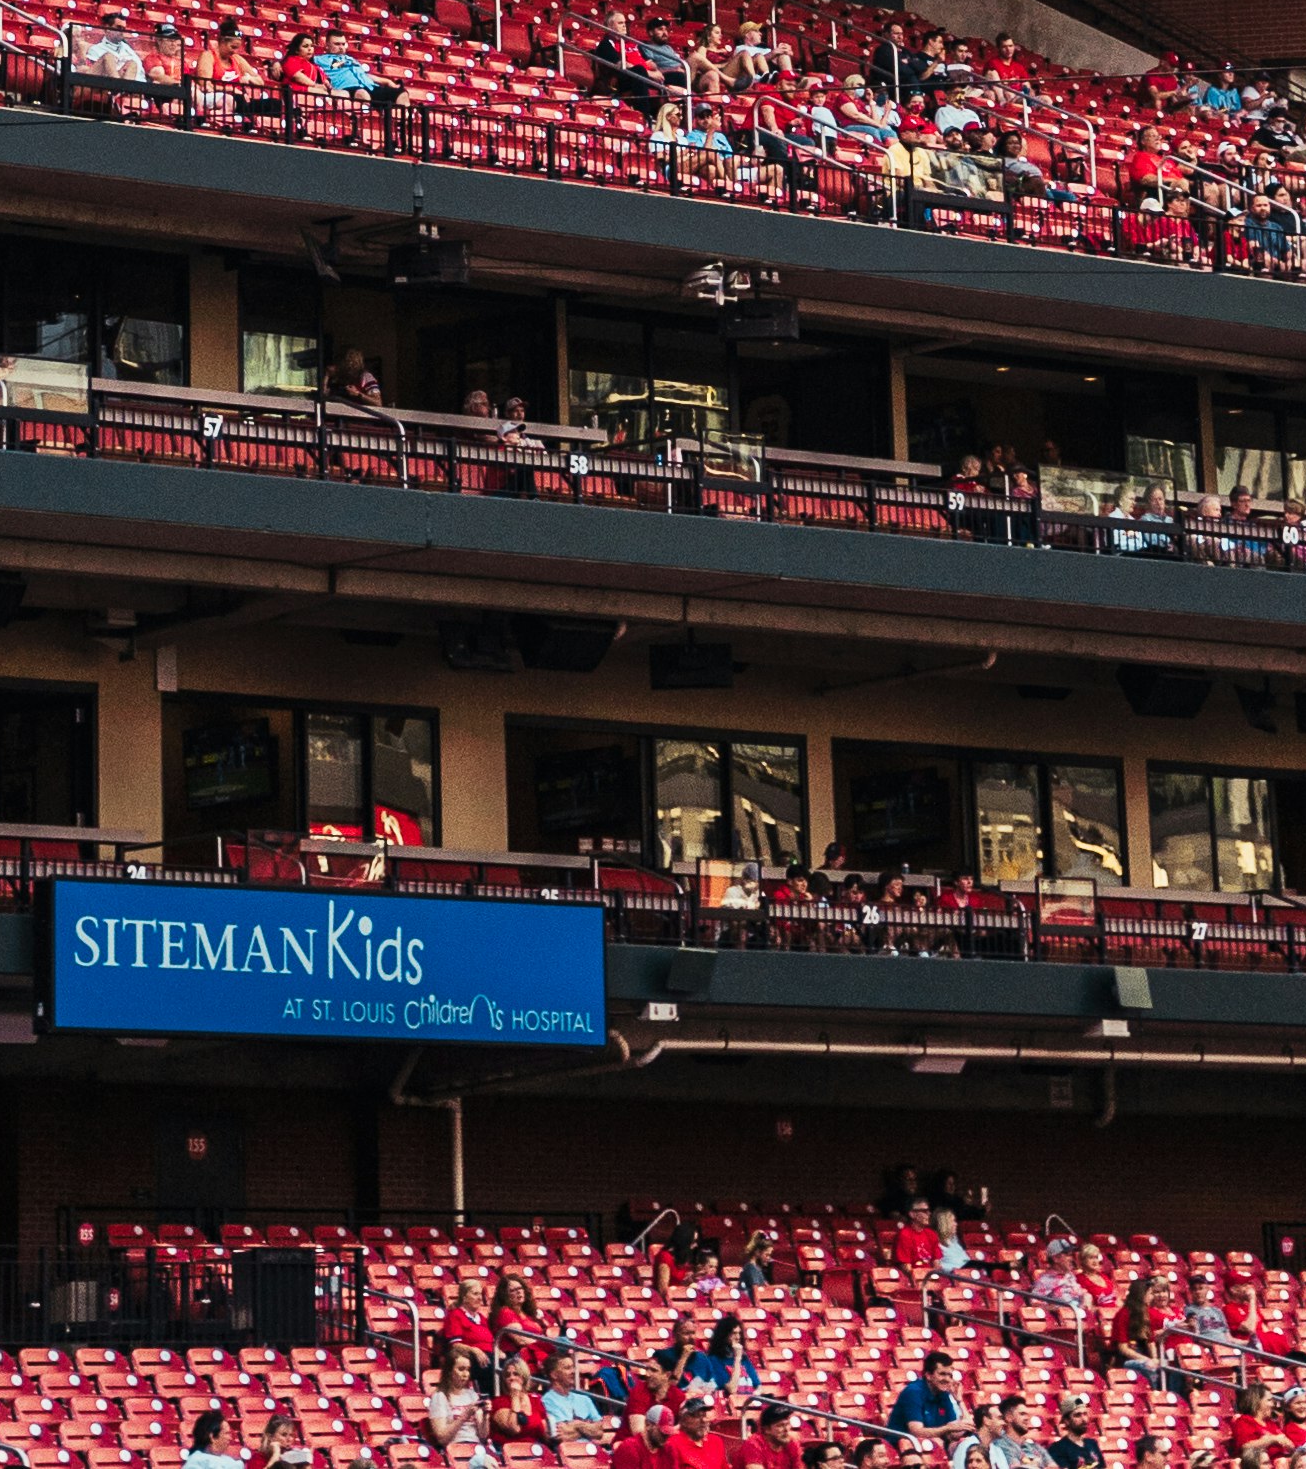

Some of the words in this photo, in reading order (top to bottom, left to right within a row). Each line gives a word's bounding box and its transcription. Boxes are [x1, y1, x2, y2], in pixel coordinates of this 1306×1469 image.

[203, 415, 224, 438] 57
[569, 454, 589, 475] 58
[948, 491, 966, 511] 59
[1282, 525, 1299, 545] 60
[862, 905, 880, 925] 26
[1191, 921, 1208, 941] 27
[282, 997, 303, 1020] AT
[312, 999, 336, 1022] ST.
[343, 1001, 395, 1025] LOUIS
[404, 994, 505, 1031] Children's
[512, 1010, 595, 1034] HOSPITAL
[188, 1138, 206, 1153] 155
